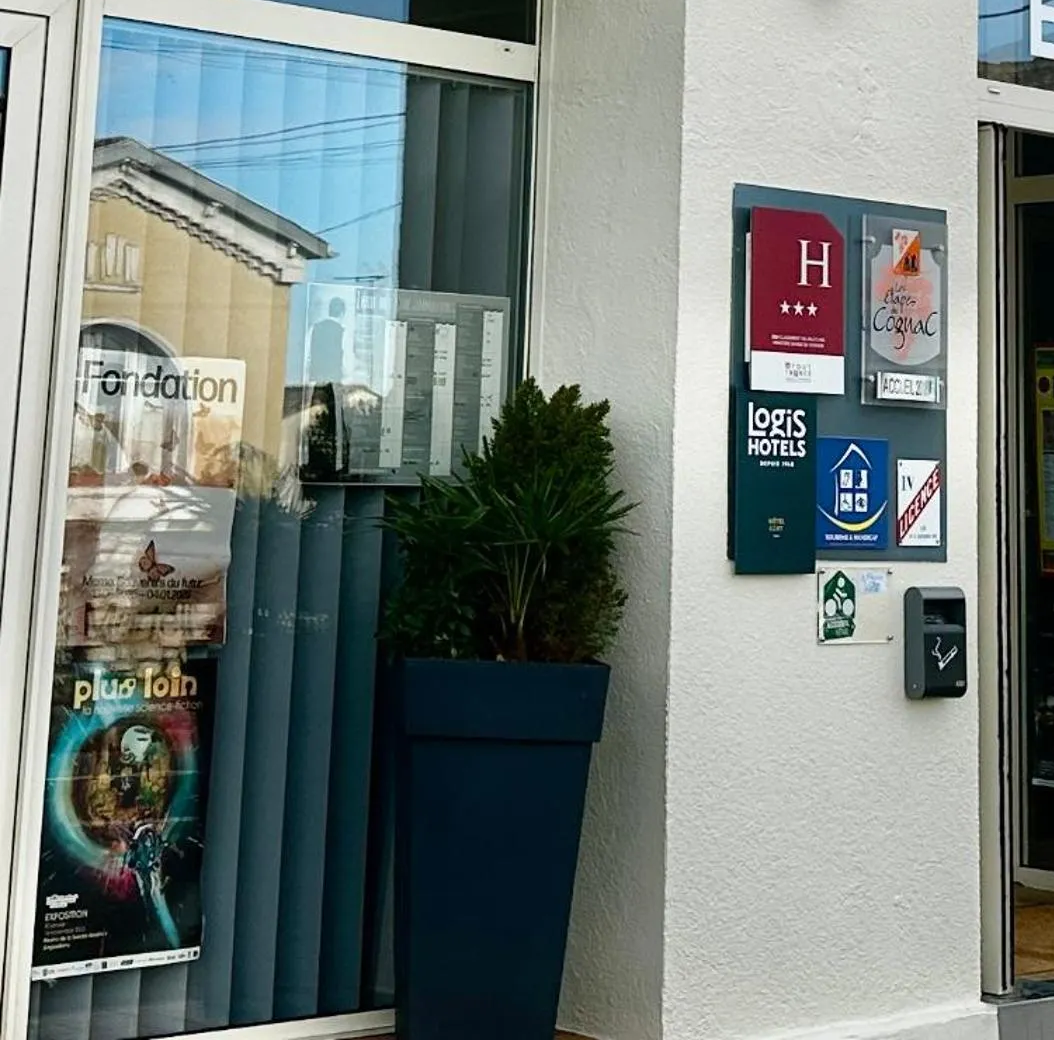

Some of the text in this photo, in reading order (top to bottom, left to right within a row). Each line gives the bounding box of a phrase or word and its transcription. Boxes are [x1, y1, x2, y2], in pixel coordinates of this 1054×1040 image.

[797, 239, 832, 288] H
[82, 360, 237, 403] Fondation
[748, 438, 806, 458] HOTELS
[144, 665, 198, 698] loin
